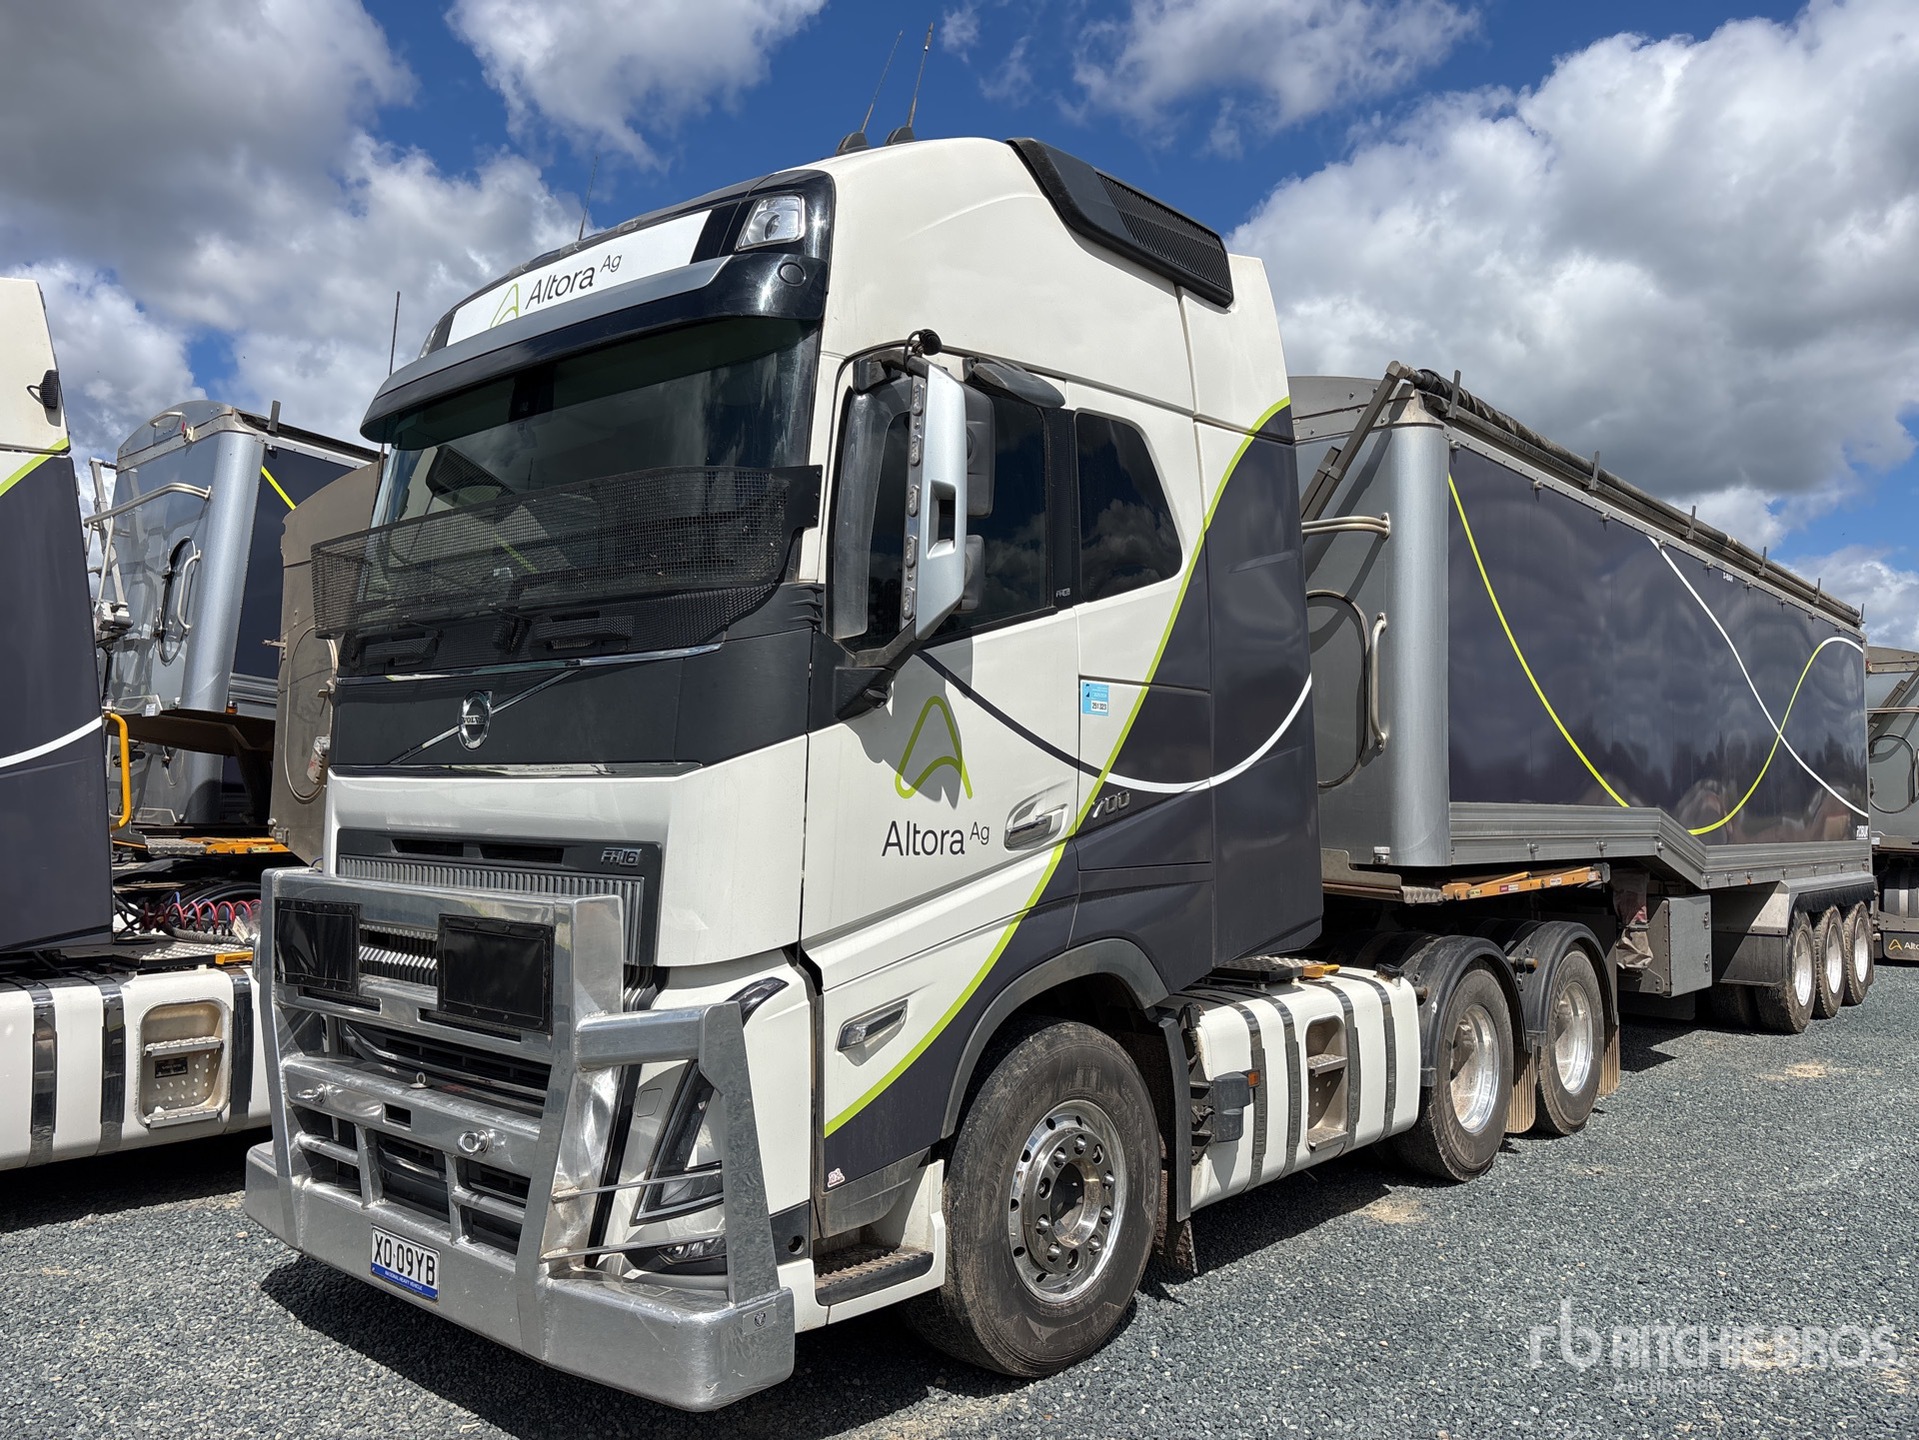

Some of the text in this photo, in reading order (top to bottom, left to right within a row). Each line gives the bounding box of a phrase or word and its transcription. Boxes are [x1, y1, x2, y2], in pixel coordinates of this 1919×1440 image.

[525, 254, 622, 310] Altora Ag
[1092, 789, 1130, 818] 700
[881, 820, 990, 857] Altora Ag
[600, 847, 642, 867] FH16
